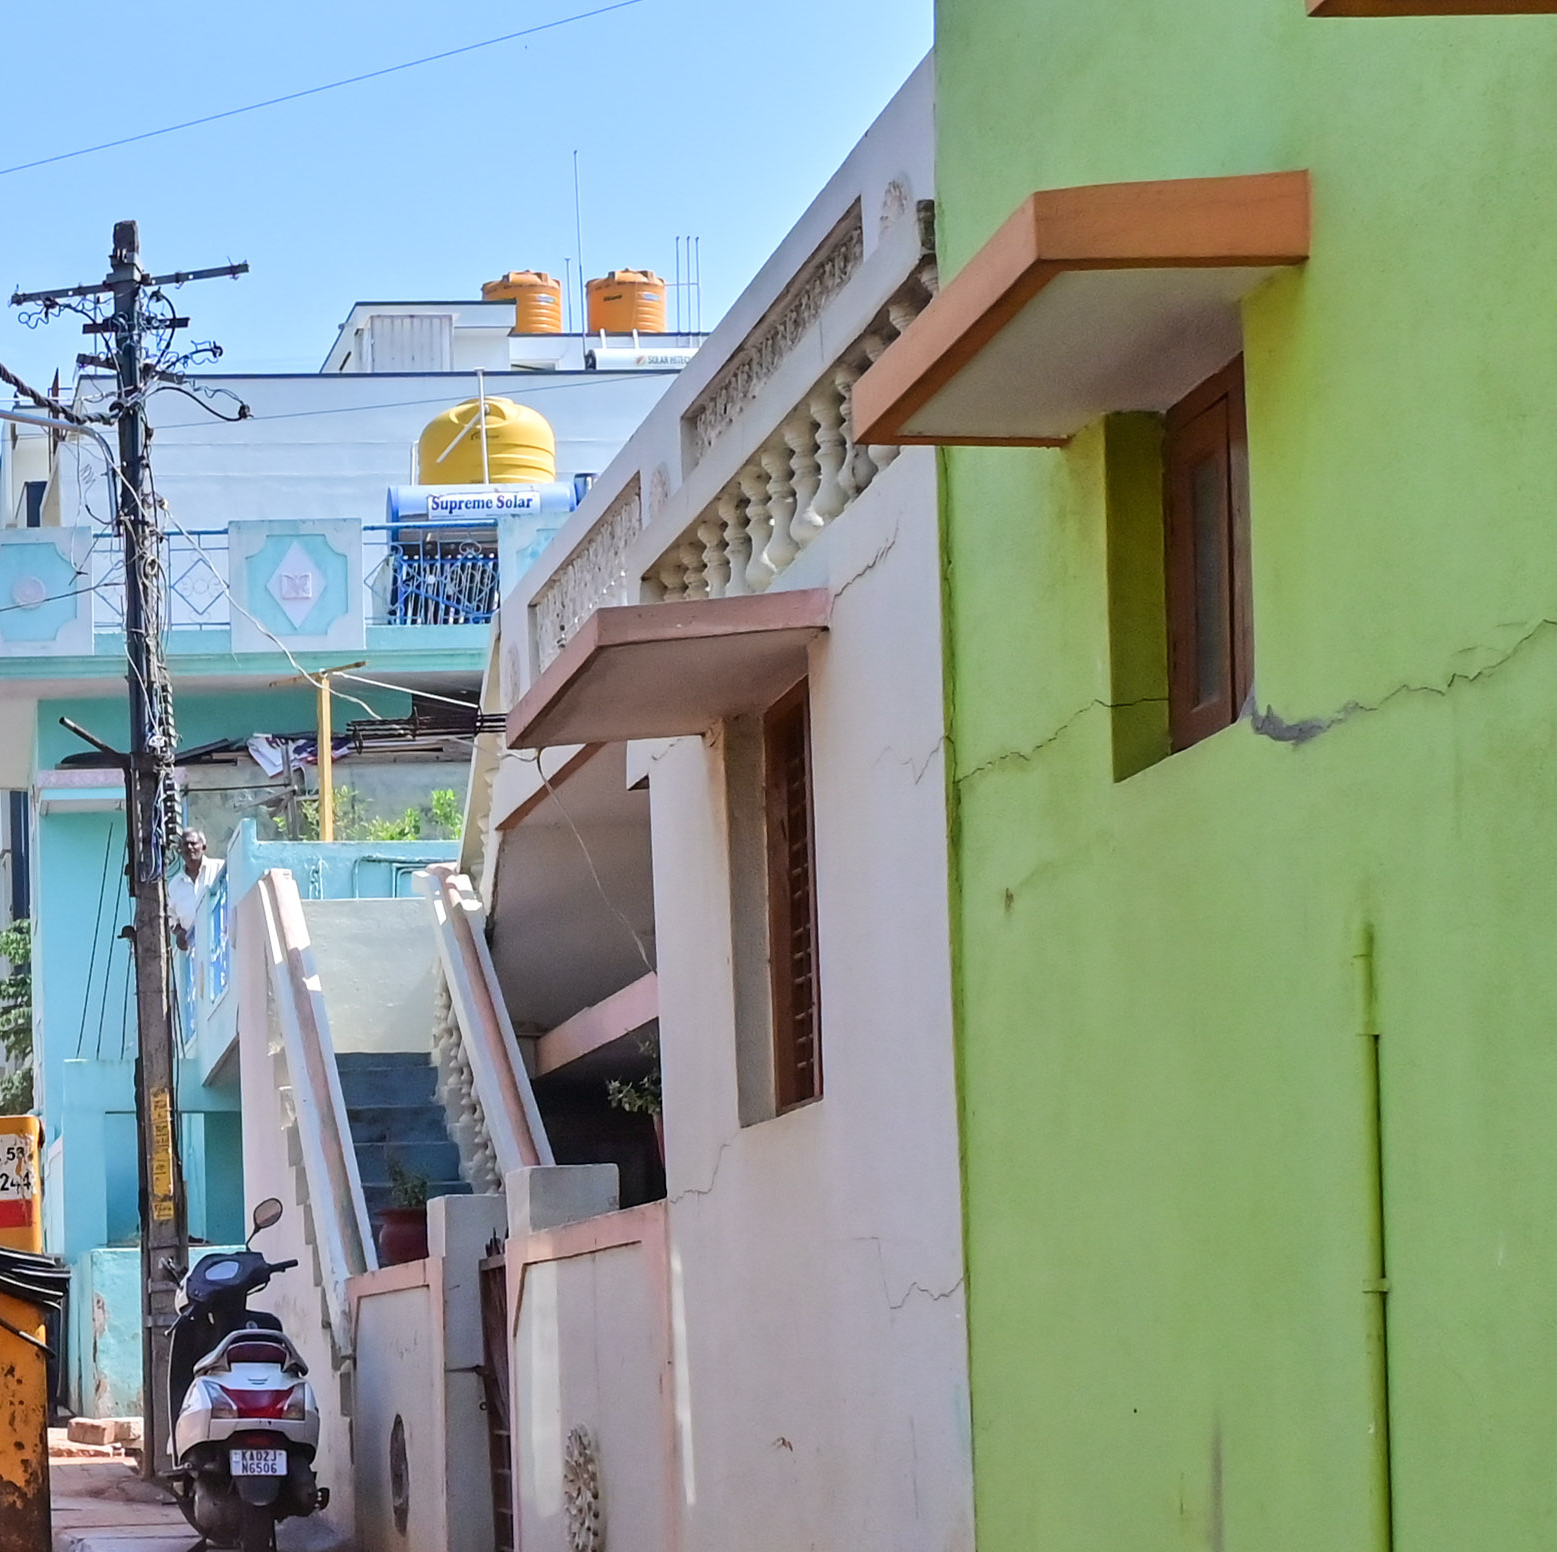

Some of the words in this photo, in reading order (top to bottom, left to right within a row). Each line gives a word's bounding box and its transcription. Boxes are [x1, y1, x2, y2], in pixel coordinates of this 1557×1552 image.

[431, 496, 493, 514] Supreme
[496, 495, 534, 509] Solar
[241, 1450, 277, 1462] KA02J
[241, 1462, 278, 1474] N6506
